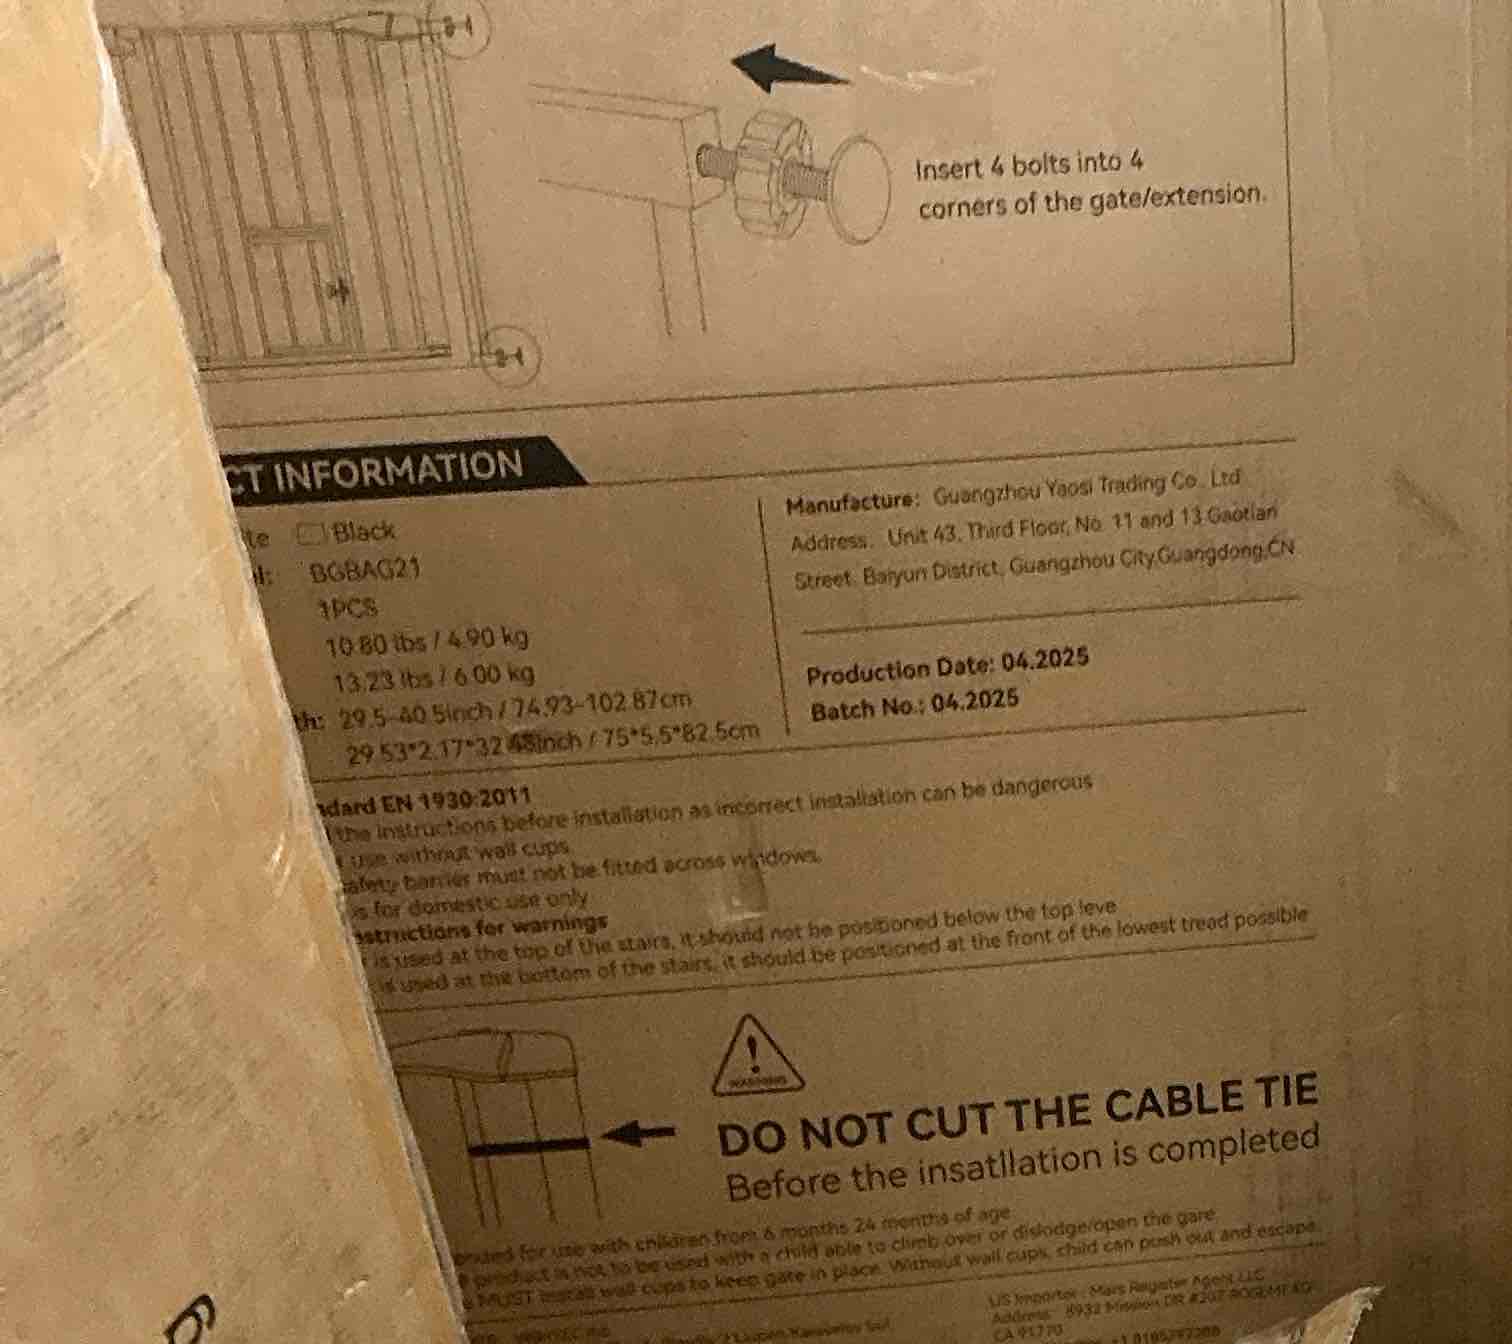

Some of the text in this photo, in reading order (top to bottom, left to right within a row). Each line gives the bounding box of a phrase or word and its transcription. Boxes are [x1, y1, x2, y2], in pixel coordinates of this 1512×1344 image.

[915, 149, 1144, 181] Insert 4 bolts into 4
[918, 183, 1266, 220] corners of the gate/extension.
[275, 449, 524, 492] INFORMATION
[785, 492, 921, 516] Manufacture:
[932, 483, 1042, 507] Guangzhou
[1097, 474, 1168, 497] Trading
[333, 521, 397, 545] Black
[1139, 508, 1175, 529] and
[500, 626, 530, 651] kg
[506, 662, 536, 687] kg
[806, 646, 1090, 686] Production Date: 04.2025
[811, 699, 876, 722] Batch
[930, 687, 1020, 713] 04.2025
[381, 794, 414, 813] EN
[500, 811, 570, 833] before
[572, 806, 684, 828] installation
[808, 788, 918, 810] installation
[921, 786, 957, 803] can
[960, 781, 988, 801] be
[990, 774, 1094, 798] dangerous
[601, 856, 659, 876] fitted
[354, 922, 472, 949] nstructions
[511, 914, 609, 935] warnings
[806, 921, 834, 939] be
[837, 911, 939, 939] positioned
[942, 908, 1001, 928] below
[1004, 904, 1037, 923] the
[1040, 899, 1076, 922] top
[839, 934, 942, 962] positioned
[945, 936, 967, 953] at
[970, 932, 1002, 950] the
[1005, 928, 1053, 947] front
[1056, 922, 1078, 944] of
[1080, 923, 1113, 941] the
[1116, 915, 1177, 938] lowest
[1233, 905, 1310, 932] possible
[717, 1071, 1319, 1156] DO NOT CUT THE CABLE TIE
[725, 1168, 842, 1202] Before
[850, 1161, 909, 1192] the
[1112, 1139, 1139, 1167] is
[1147, 1120, 1320, 1166] completed
[988, 1226, 1009, 1243] or
[1138, 1231, 1182, 1254] push
